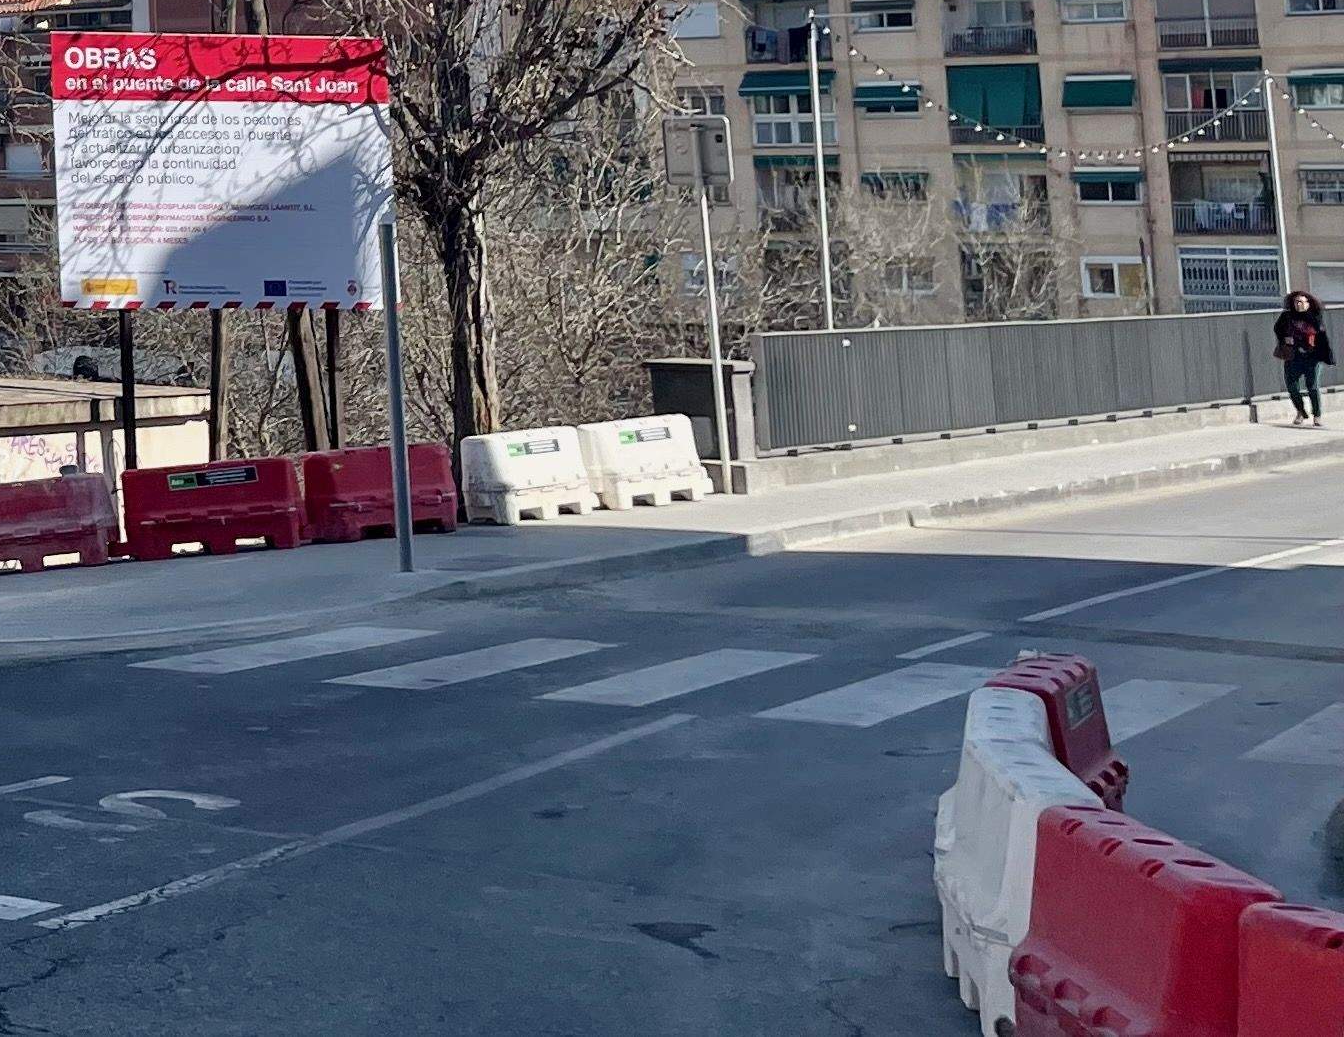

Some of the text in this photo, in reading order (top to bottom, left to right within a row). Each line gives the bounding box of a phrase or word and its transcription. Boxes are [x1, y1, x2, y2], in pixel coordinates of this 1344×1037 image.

[64, 46, 157, 70] OBRAS
[65, 74, 359, 94] en el puente de la calle Sant Joan
[68, 112, 116, 127] Mejorar
[120, 113, 131, 124] la
[135, 112, 198, 127] seguridad
[201, 113, 217, 125] de
[221, 113, 240, 125] los
[68, 128, 90, 140] del
[176, 129, 230, 140] accesos
[233, 128, 245, 140] al
[81, 142, 142, 154] actualizar
[149, 157, 161, 169] la
[162, 158, 237, 170] continuidad
[70, 172, 91, 184] del
[95, 173, 144, 187] espacio
